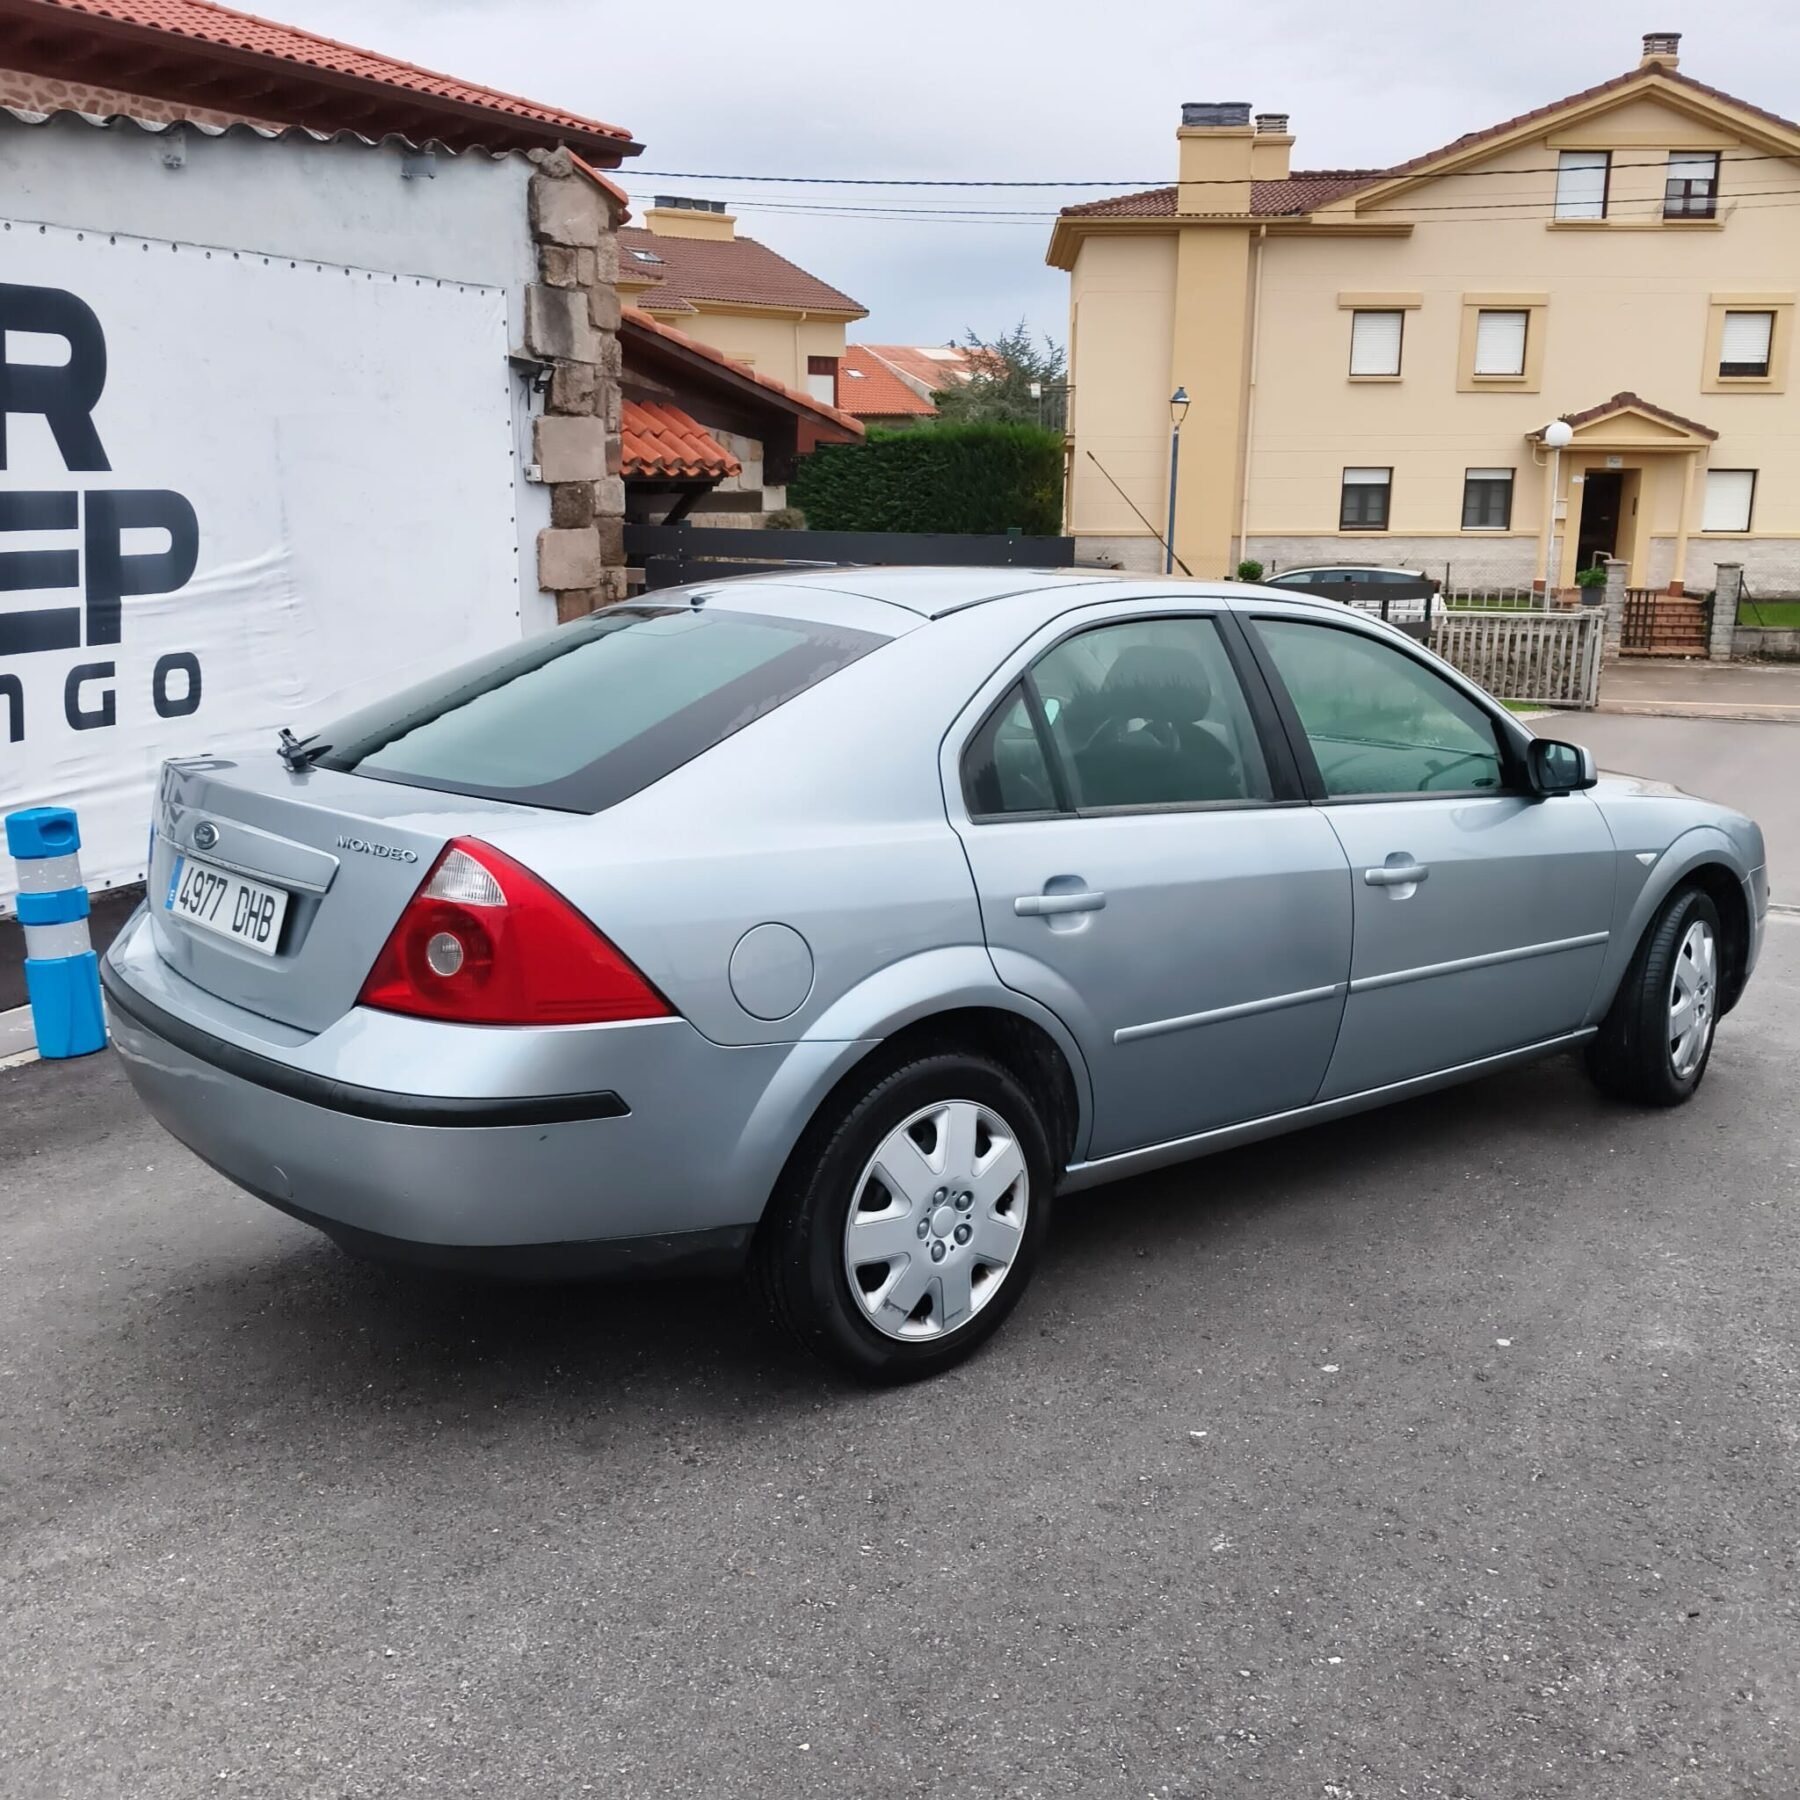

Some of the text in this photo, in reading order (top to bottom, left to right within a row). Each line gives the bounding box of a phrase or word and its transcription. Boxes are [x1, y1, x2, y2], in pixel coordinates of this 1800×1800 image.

[336, 834, 418, 864] MONDEO
[179, 866, 275, 943] 4977 DHB
